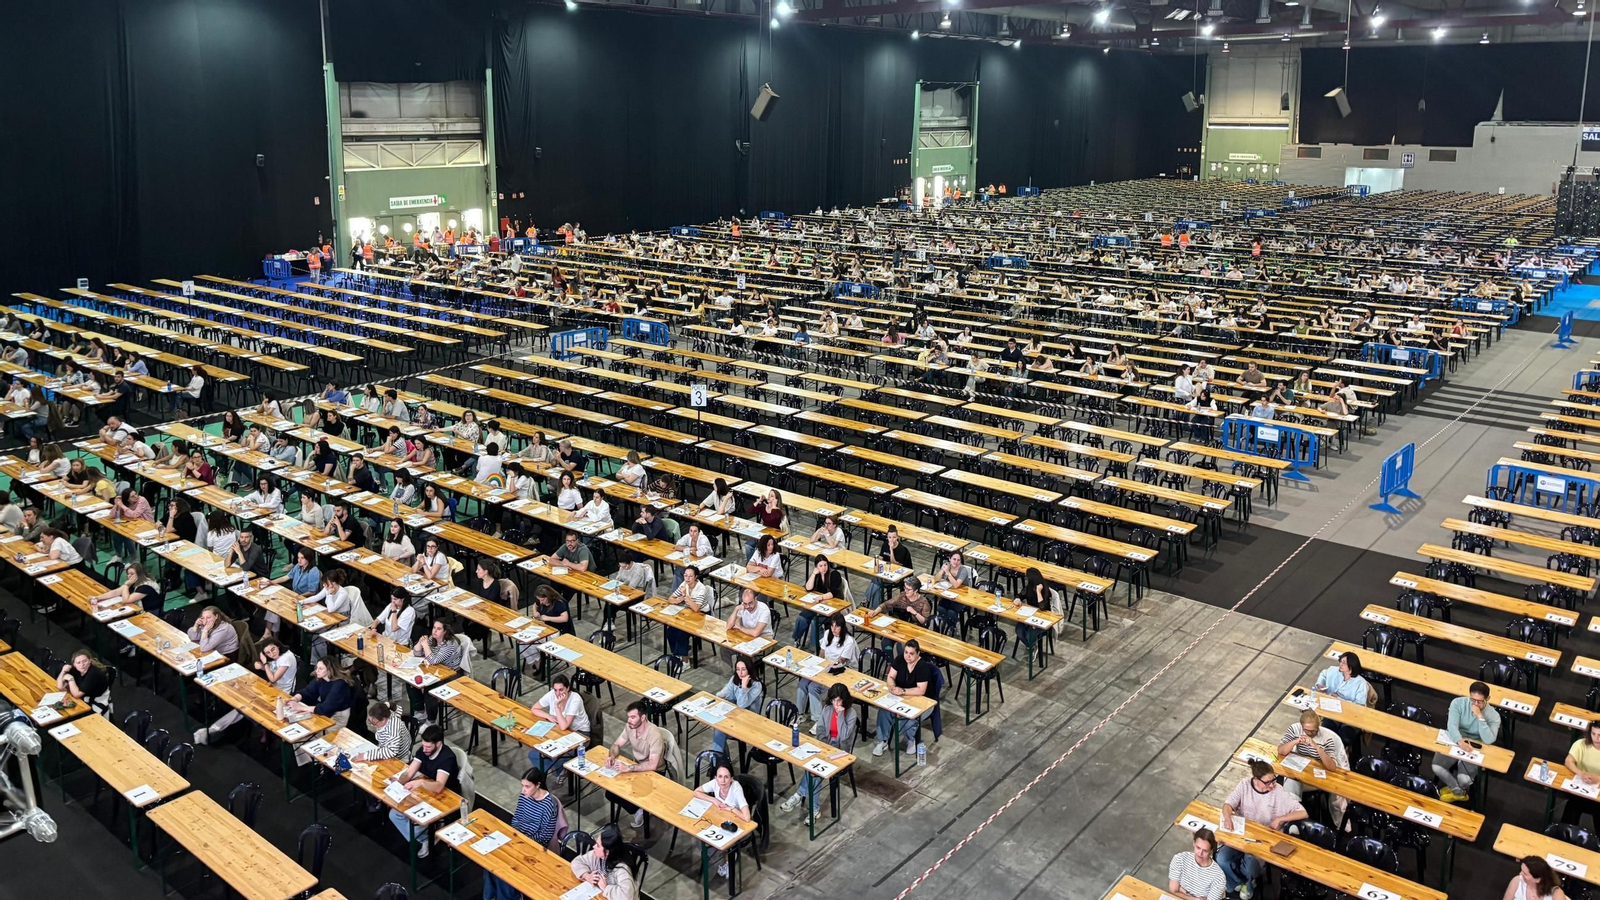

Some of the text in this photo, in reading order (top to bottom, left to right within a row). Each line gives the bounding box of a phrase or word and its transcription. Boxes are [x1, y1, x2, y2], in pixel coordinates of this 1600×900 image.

[739, 279, 744, 288] 5
[185, 285, 192, 293] 4
[695, 390, 703, 406] 3
[1081, 582, 1100, 591] 109
[770, 657, 785, 665] 62
[970, 659, 985, 667] 77
[435, 688, 452, 697] 32
[649, 690, 666, 698] 47
[1294, 698, 1310, 708] 93
[1504, 701, 1531, 712] 110
[896, 706, 912, 714] 61
[1559, 715, 1584, 726] 111
[57, 728, 70, 736] 2
[284, 727, 301, 737] 17
[310, 742, 323, 753] 16
[541, 742, 558, 753] 31
[810, 761, 829, 773] 45
[133, 790, 147, 798] 1
[412, 806, 431, 818] 15
[1413, 810, 1433, 822] 78
[704, 830, 725, 842] 29
[1554, 858, 1578, 872] 79
[1367, 889, 1389, 900] 62
